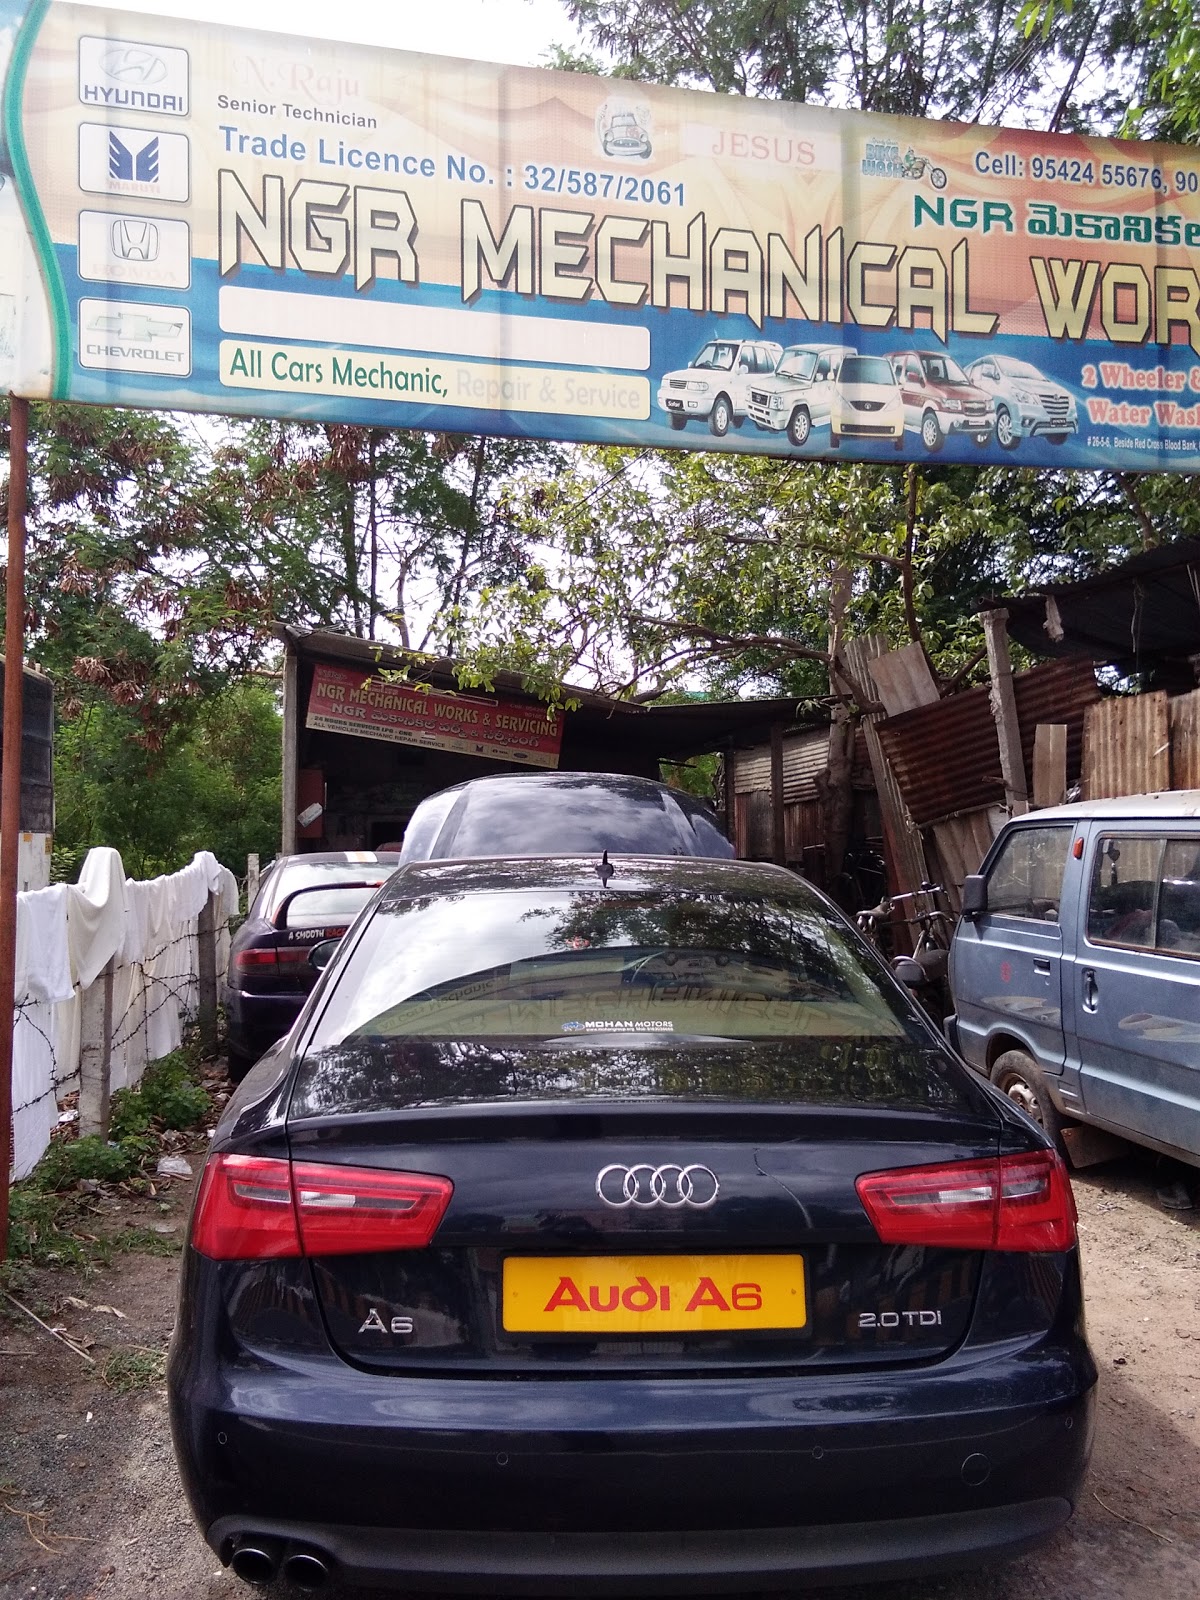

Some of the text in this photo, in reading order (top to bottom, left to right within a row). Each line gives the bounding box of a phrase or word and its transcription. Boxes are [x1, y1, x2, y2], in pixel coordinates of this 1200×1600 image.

[84, 85, 183, 112] HYUNDAI
[279, 62, 361, 105] Raju
[217, 95, 378, 129] Senior Technician
[712, 131, 817, 165] JESUS
[219, 126, 306, 161] Trade
[318, 139, 436, 178] Licence
[446, 154, 495, 185] No.
[524, 165, 686, 207] 32/587/2061
[862, 159, 903, 178] WASH
[975, 151, 1023, 176] Cell:
[1032, 158, 1094, 184] 95424
[1102, 163, 1168, 193] 55676,
[914, 195, 1013, 234] NGR
[218, 168, 419, 292] NGR
[461, 197, 1000, 346] MECHANICAL
[86, 344, 185, 363] CHEVROLET
[229, 347, 641, 410] All Cars Mechanic, Repair & Service
[1082, 364, 1097, 388] 2
[1099, 361, 1186, 392] Wheeler
[1087, 397, 1200, 428] Water Was
[1114, 437, 1134, 448] Beside
[1135, 438, 1146, 449] Red
[1165, 440, 1181, 450] Blood
[317, 682, 346, 701] NGR
[350, 688, 429, 715] MECHANICAL
[434, 703, 479, 724] WORKS
[482, 713, 491, 726] &
[495, 715, 558, 736] SERVICING
[331, 703, 367, 719] NGR
[327, 724, 359, 734] VEHICLES
[360, 729, 394, 740] MECHANIC
[395, 735, 418, 743] REPAIR
[419, 739, 446, 748] SERVICE
[348, 721, 380, 732] SERVICES
[289, 931, 294, 940] A
[295, 929, 325, 940] SMOOTH
[543, 1276, 763, 1313] Audi A6
[358, 1308, 414, 1334] A6
[858, 1312, 898, 1329] 2.0
